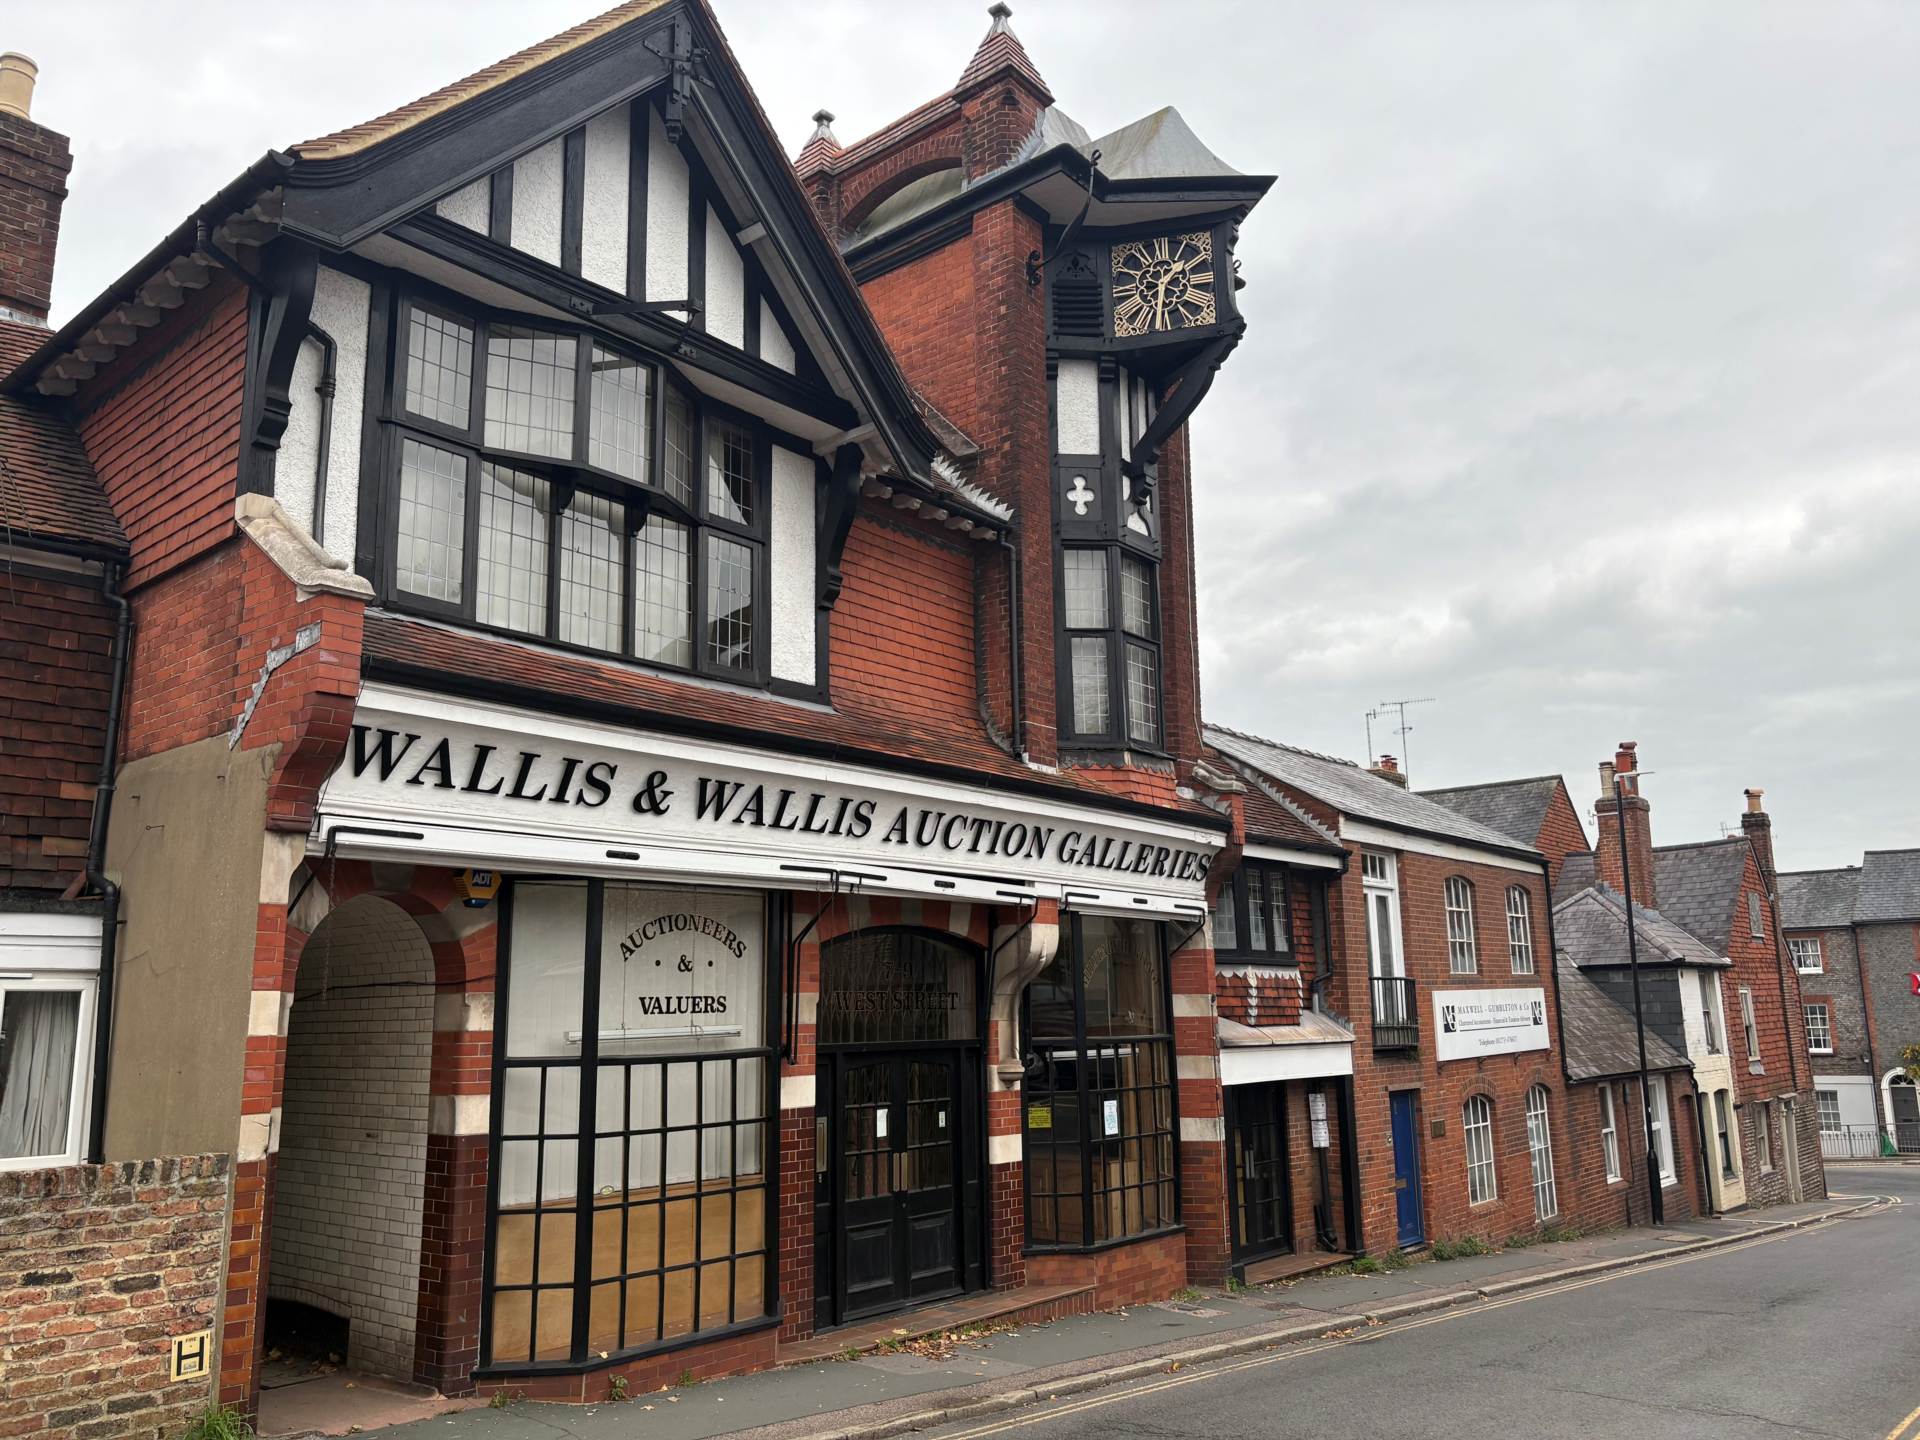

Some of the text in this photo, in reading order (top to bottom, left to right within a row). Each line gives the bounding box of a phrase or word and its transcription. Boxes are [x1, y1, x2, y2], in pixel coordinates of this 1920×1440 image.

[351, 724, 1212, 881] WALLIS & WALLIS AUCTION GALLERIES
[472, 872, 492, 886] ADT
[619, 913, 747, 962] AUCTIONEERS
[677, 954, 693, 972] &
[638, 996, 727, 1015] VALUERS
[834, 991, 959, 1010] WEST STREET
[176, 1336, 205, 1376] H
